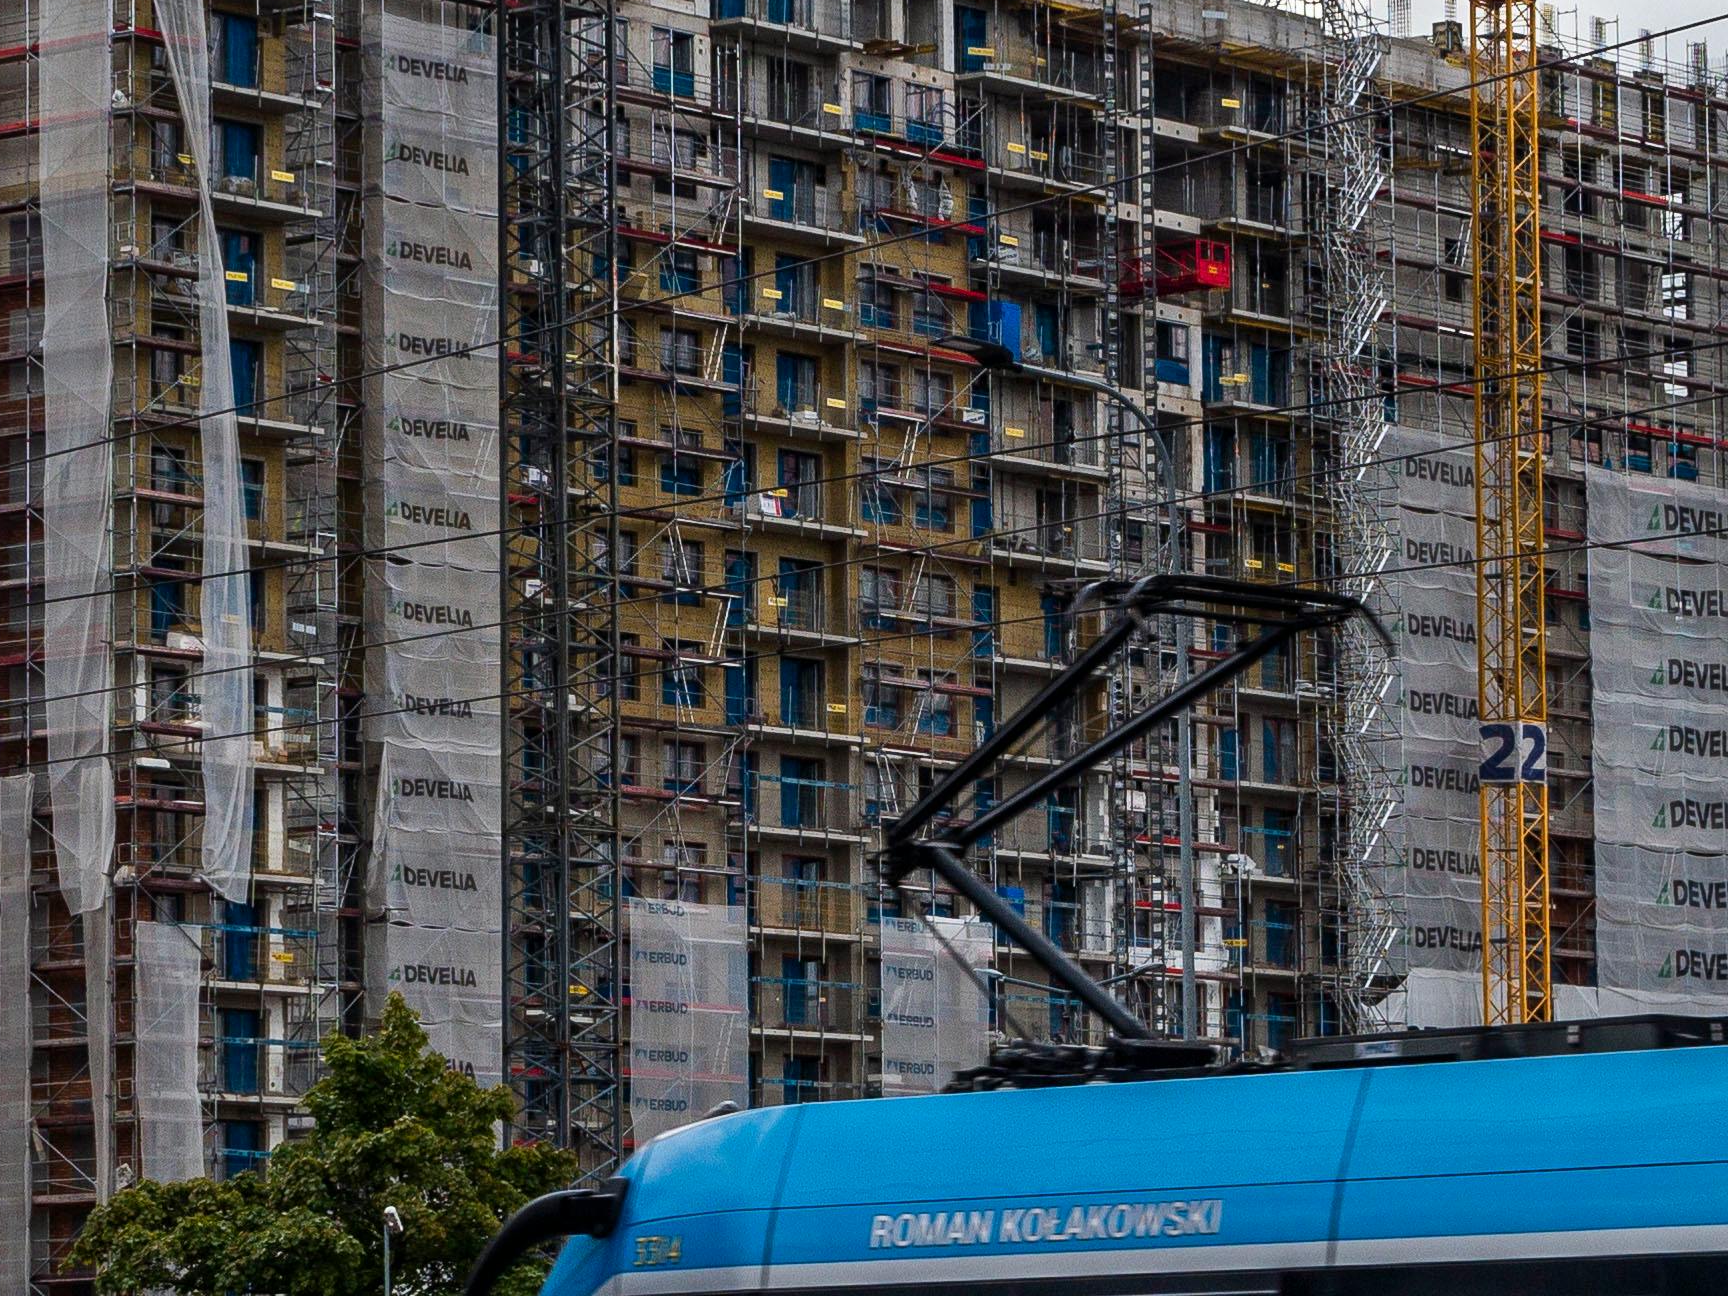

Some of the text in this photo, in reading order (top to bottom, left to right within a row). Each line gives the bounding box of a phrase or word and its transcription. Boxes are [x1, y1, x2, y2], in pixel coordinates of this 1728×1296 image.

[398, 56, 468, 85] DEVELIA
[398, 143, 470, 176] DEVELIA
[399, 241, 473, 271] DEVELIA
[399, 333, 471, 360] DEVELIA
[401, 417, 470, 441] DEVELIA
[1406, 456, 1475, 488] DEVELIA
[400, 502, 472, 530] DEVELIA
[403, 602, 472, 627] DEVELIA
[1408, 612, 1476, 644] DEVELIA
[1410, 690, 1479, 720] DEVELIA
[401, 778, 474, 802] DEVELIA
[1411, 765, 1480, 794] DEVELIA
[1413, 847, 1481, 876] DEVELIA
[403, 864, 478, 892] DEVELIA
[1415, 925, 1483, 952] DEVELIA
[649, 951, 688, 966] ERBUD
[404, 964, 477, 987] DEVELIA
[898, 967, 934, 981] ERBUD
[650, 1000, 688, 1014] ERBUD
[649, 1049, 688, 1063] ERBUD
[899, 1062, 935, 1075] ERBUD
[649, 1098, 688, 1112] ERBUD
[869, 1198, 1225, 1250] ROMAN KOŁAKOWSKI
